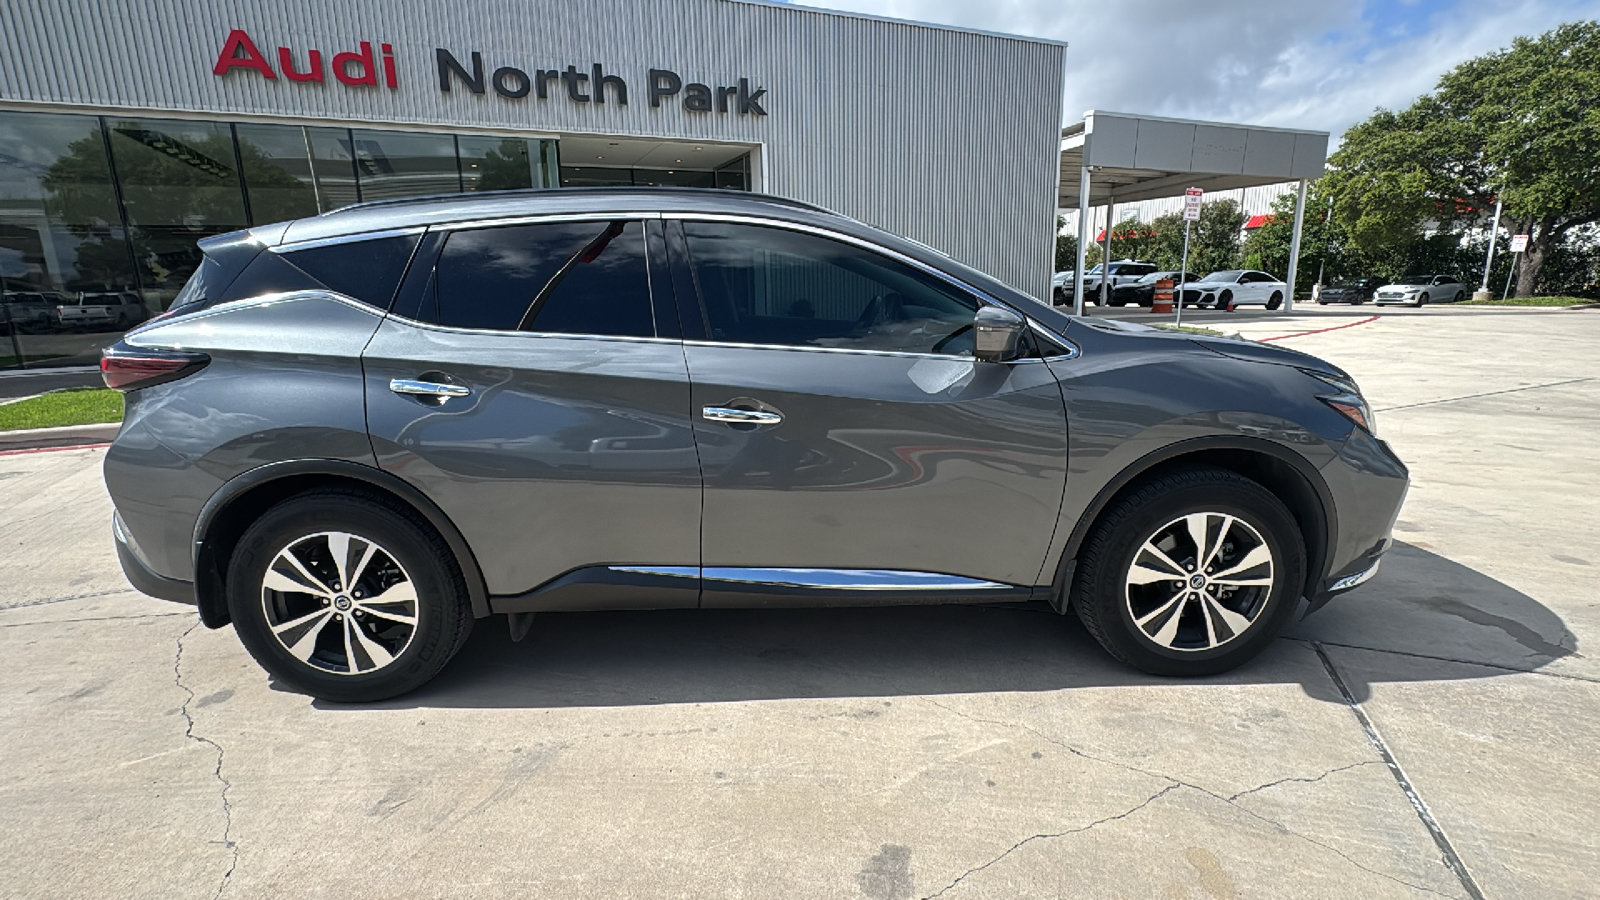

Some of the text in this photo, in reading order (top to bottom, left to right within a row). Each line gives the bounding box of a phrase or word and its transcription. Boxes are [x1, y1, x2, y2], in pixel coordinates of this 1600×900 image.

[213, 28, 767, 116] Audi North Park
